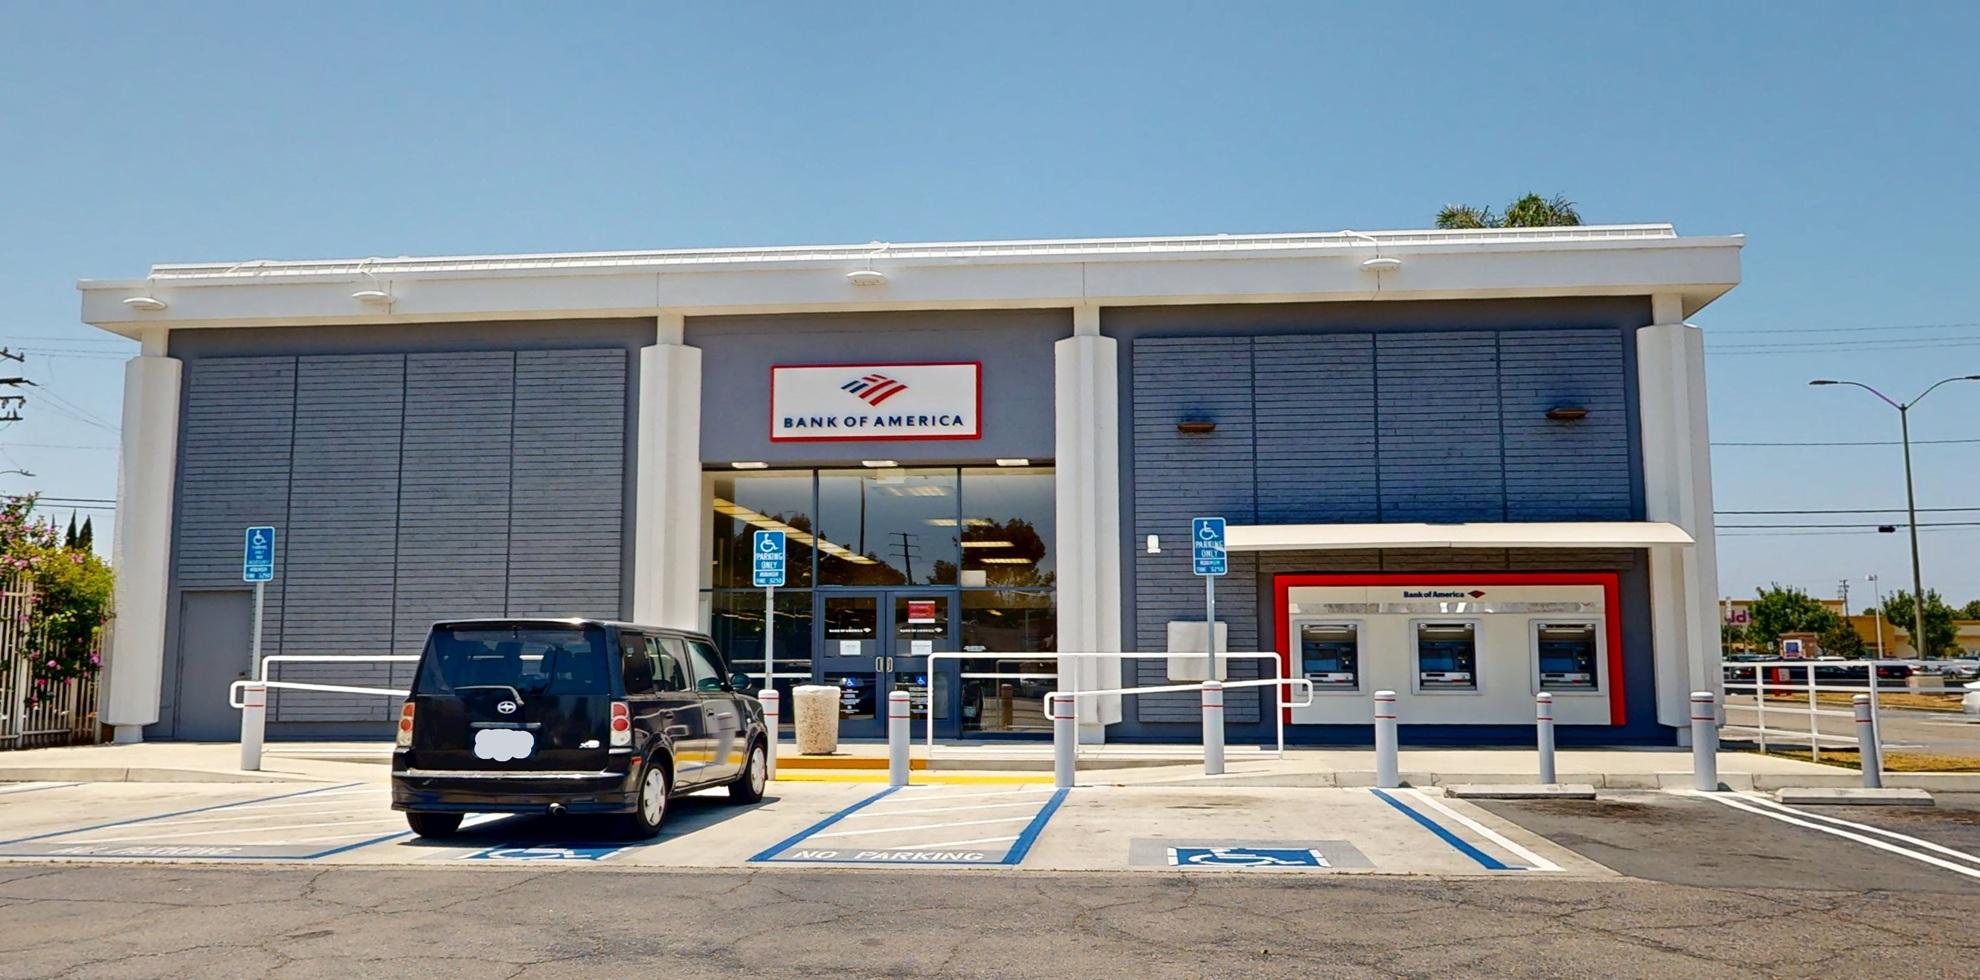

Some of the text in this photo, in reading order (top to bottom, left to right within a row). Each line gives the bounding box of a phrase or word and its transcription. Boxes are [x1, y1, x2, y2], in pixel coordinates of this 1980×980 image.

[783, 414, 964, 429] BANK OF AMERICA
[756, 552, 783, 560] PARKING
[1201, 550, 1217, 558] ONLY
[761, 561, 778, 569] ONLY
[792, 850, 984, 860] NO PARKING
